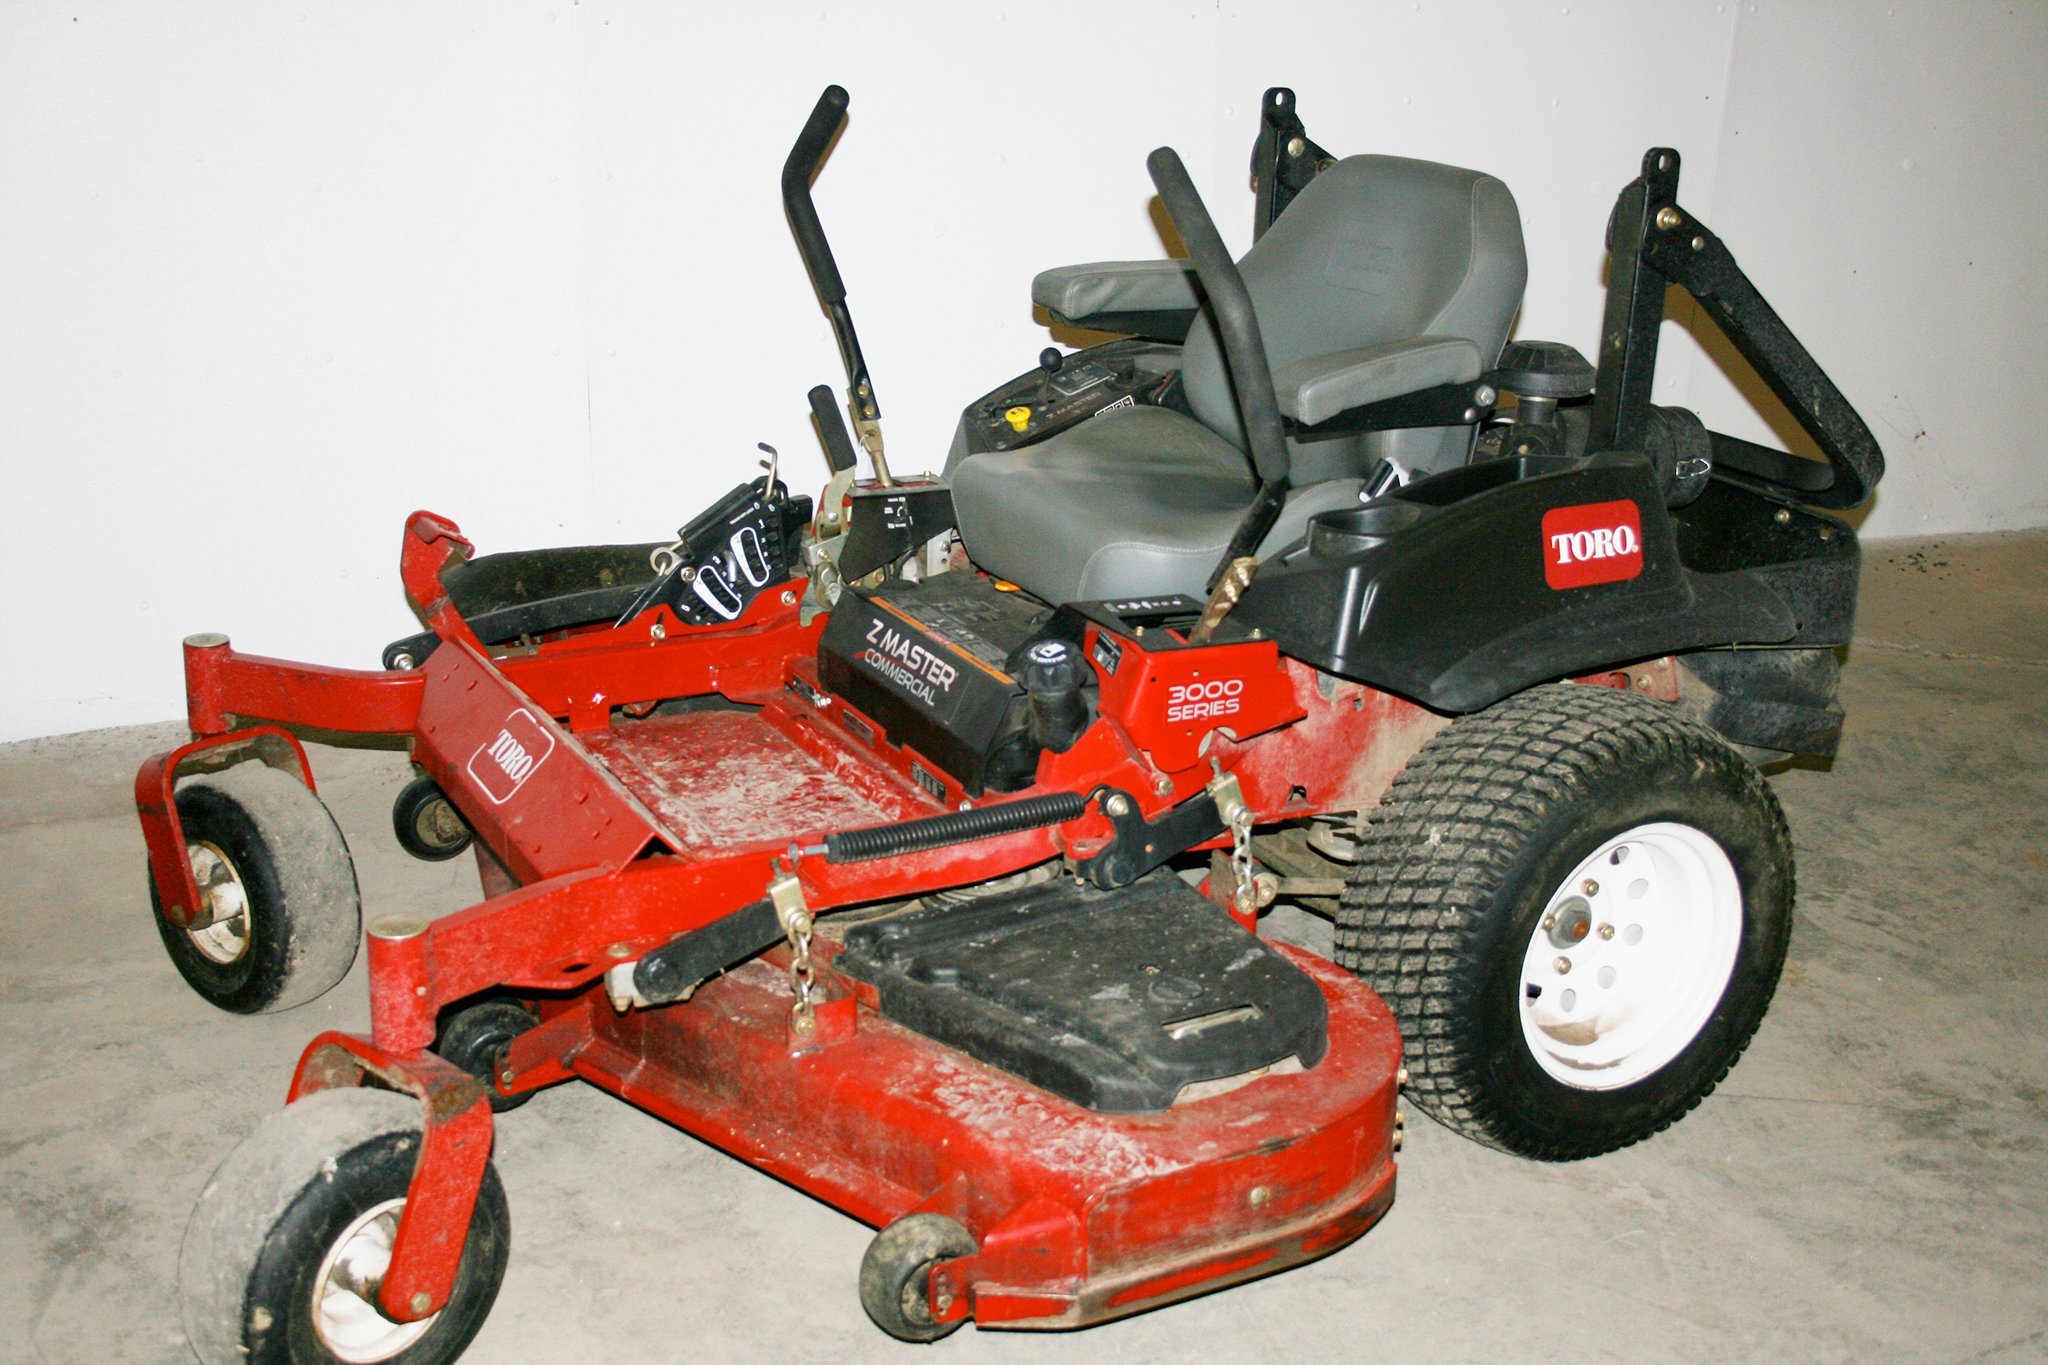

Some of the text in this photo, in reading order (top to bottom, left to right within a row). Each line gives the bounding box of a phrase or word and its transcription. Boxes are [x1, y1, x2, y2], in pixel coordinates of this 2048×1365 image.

[1551, 526, 1634, 564] TORO
[866, 618, 884, 644] Z
[879, 628, 956, 692] MASTER
[864, 648, 935, 707] COMMERCIAL
[1168, 680, 1243, 704] 3000
[1167, 698, 1240, 722] SERIES
[487, 729, 533, 780] TORO
